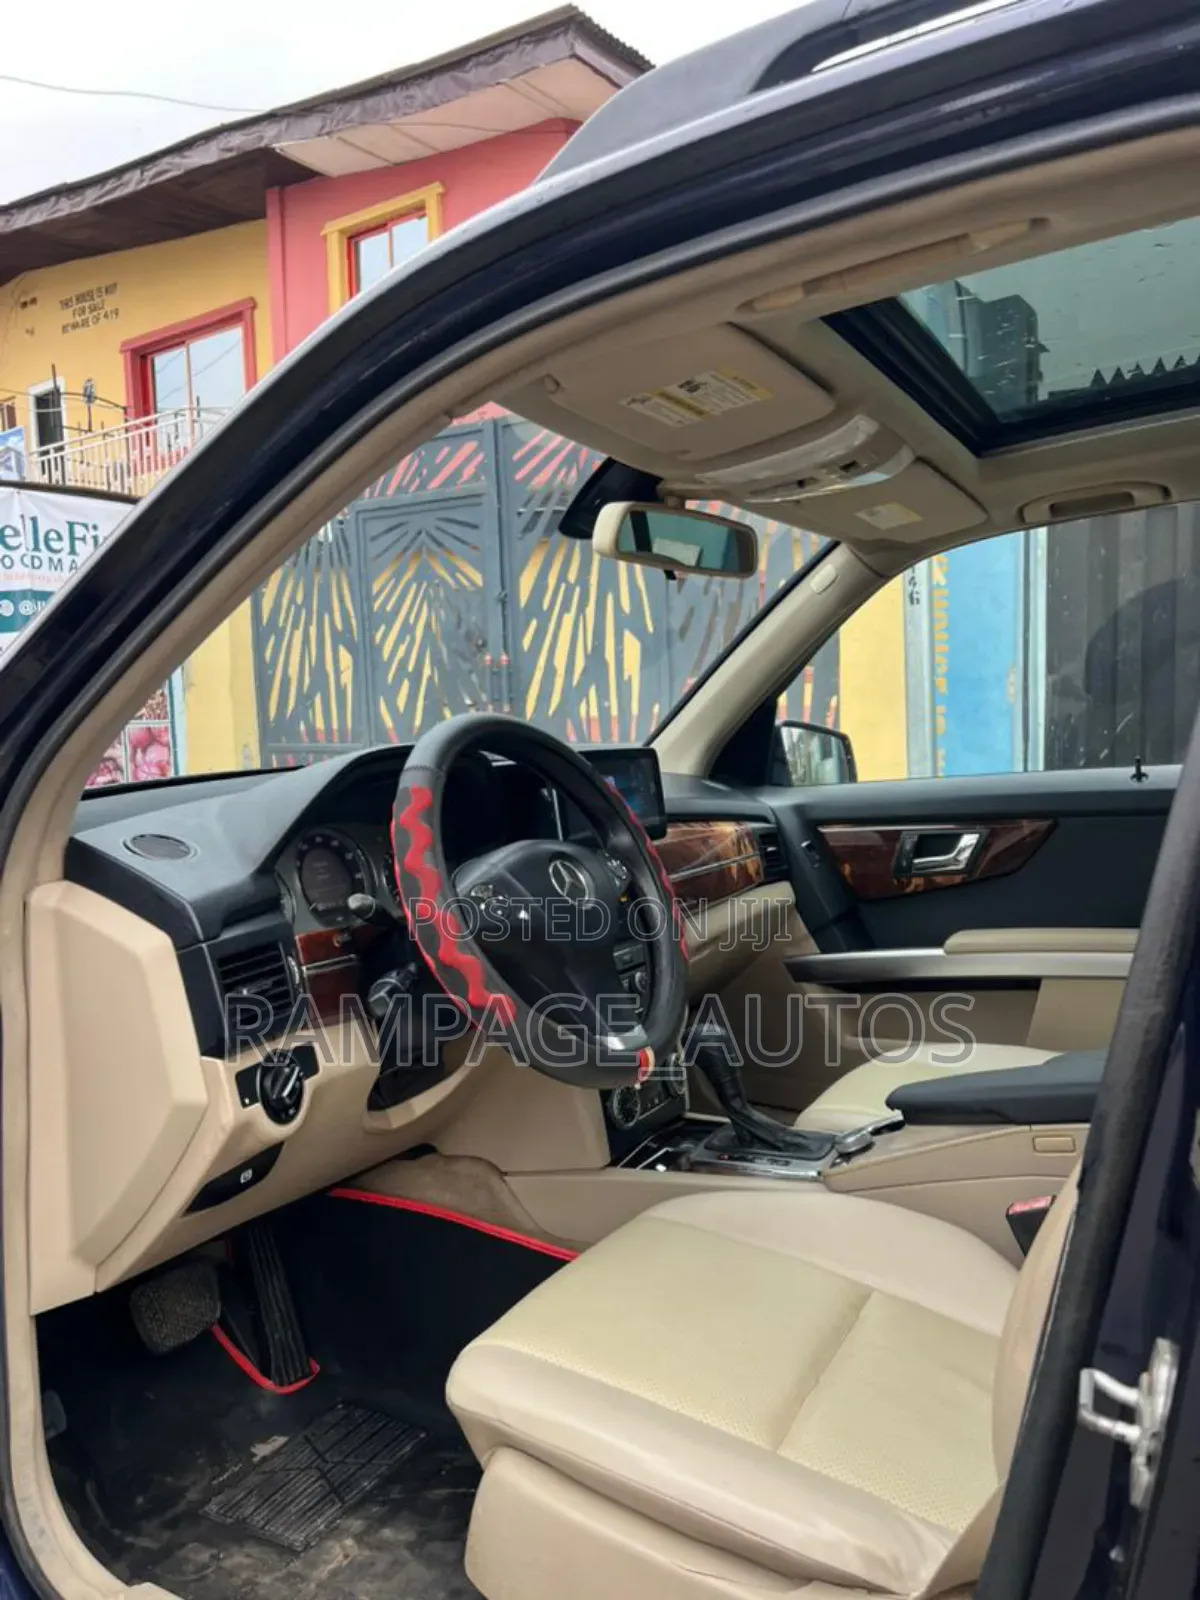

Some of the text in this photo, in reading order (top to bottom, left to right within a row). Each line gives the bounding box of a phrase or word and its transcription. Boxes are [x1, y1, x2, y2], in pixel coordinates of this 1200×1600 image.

[59, 296, 73, 310] THIS
[74, 289, 95, 305] HOUSE
[72, 299, 105, 318] FOR SALE
[62, 307, 119, 335] BEWARE OF 419
[0, 514, 108, 556] elleFi
